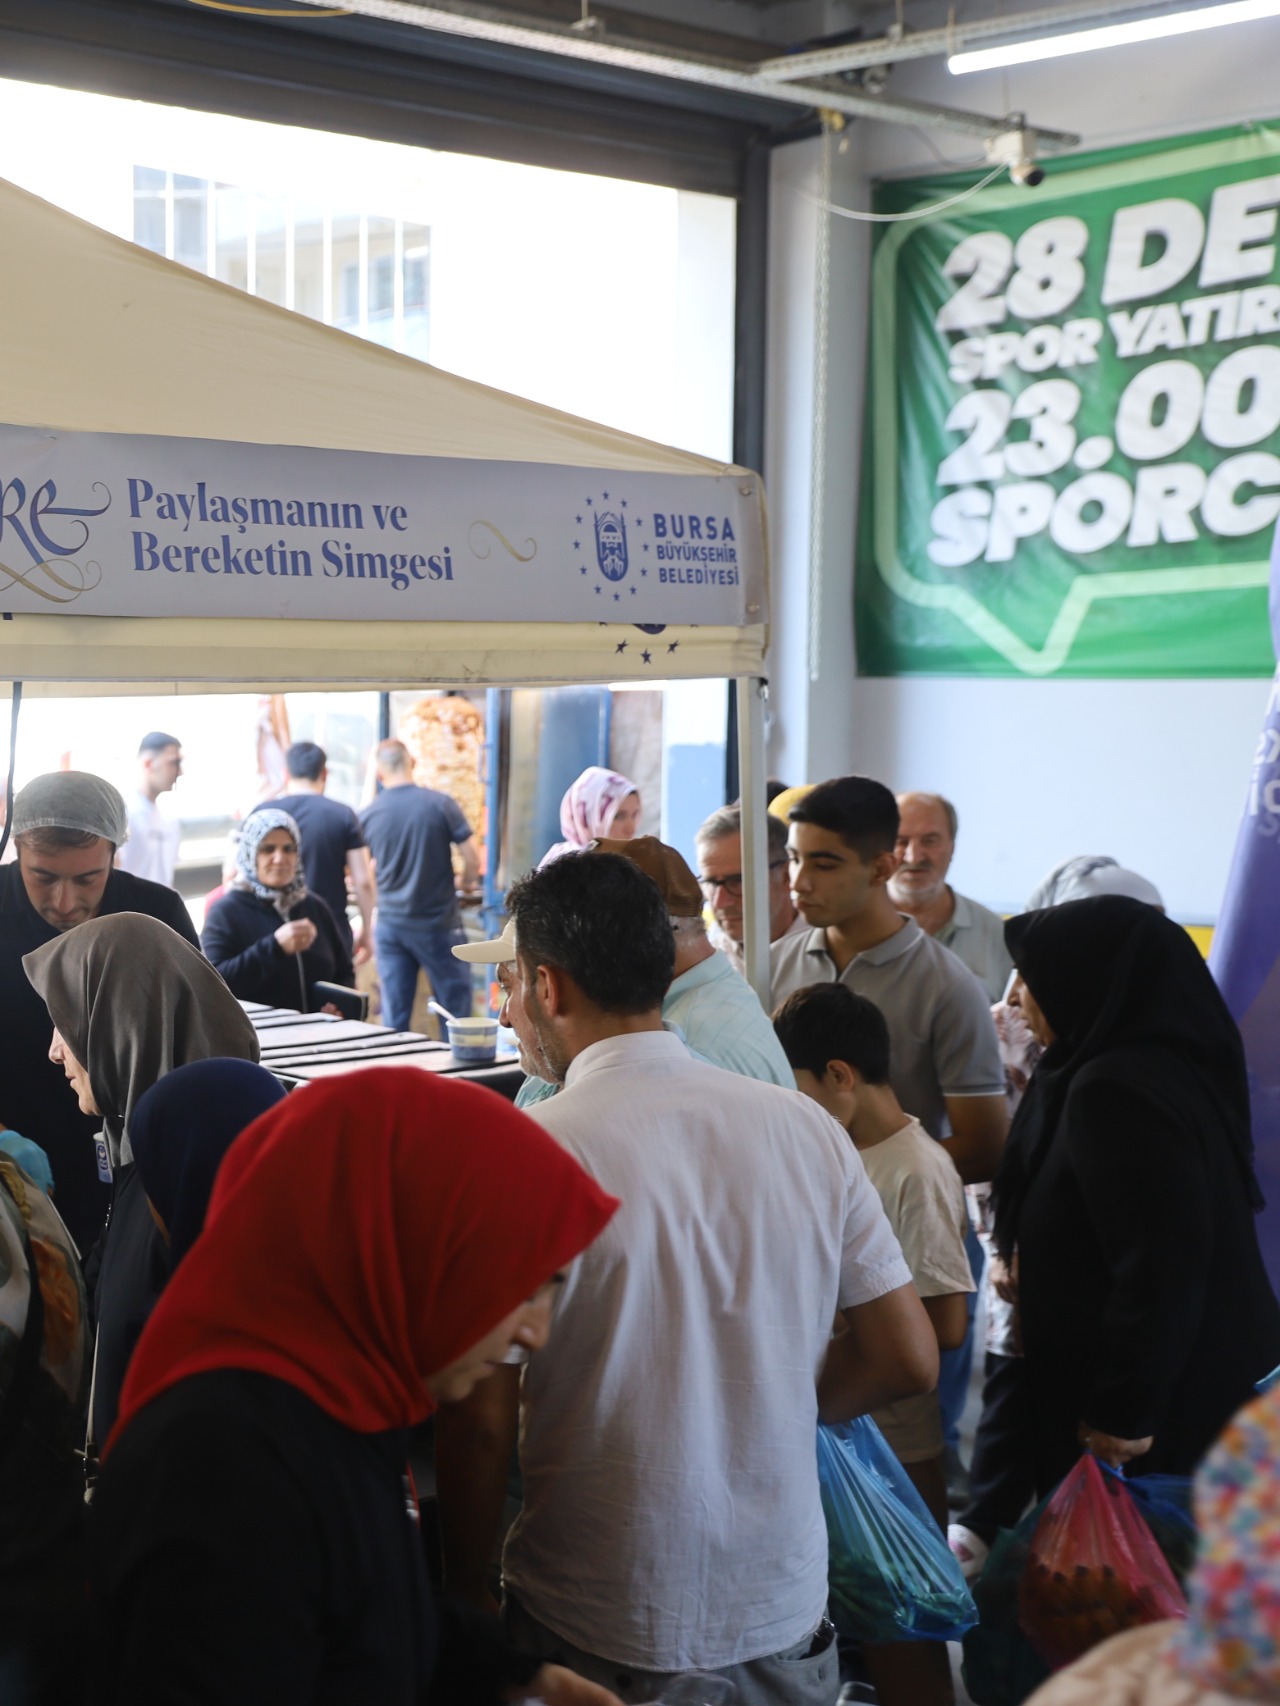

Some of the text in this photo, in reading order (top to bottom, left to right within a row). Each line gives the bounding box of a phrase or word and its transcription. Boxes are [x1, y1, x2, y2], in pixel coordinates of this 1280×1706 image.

[936, 216, 1089, 332] 28
[948, 317, 1103, 384] SPOR
[127, 477, 408, 533] Paylaşmanın ve
[653, 513, 735, 542] BURSA
[132, 531, 454, 590] Bereketin Simgesi
[656, 541, 738, 564] BÜYÜKŞEHİR
[659, 563, 739, 585] BELEDİYESİ
